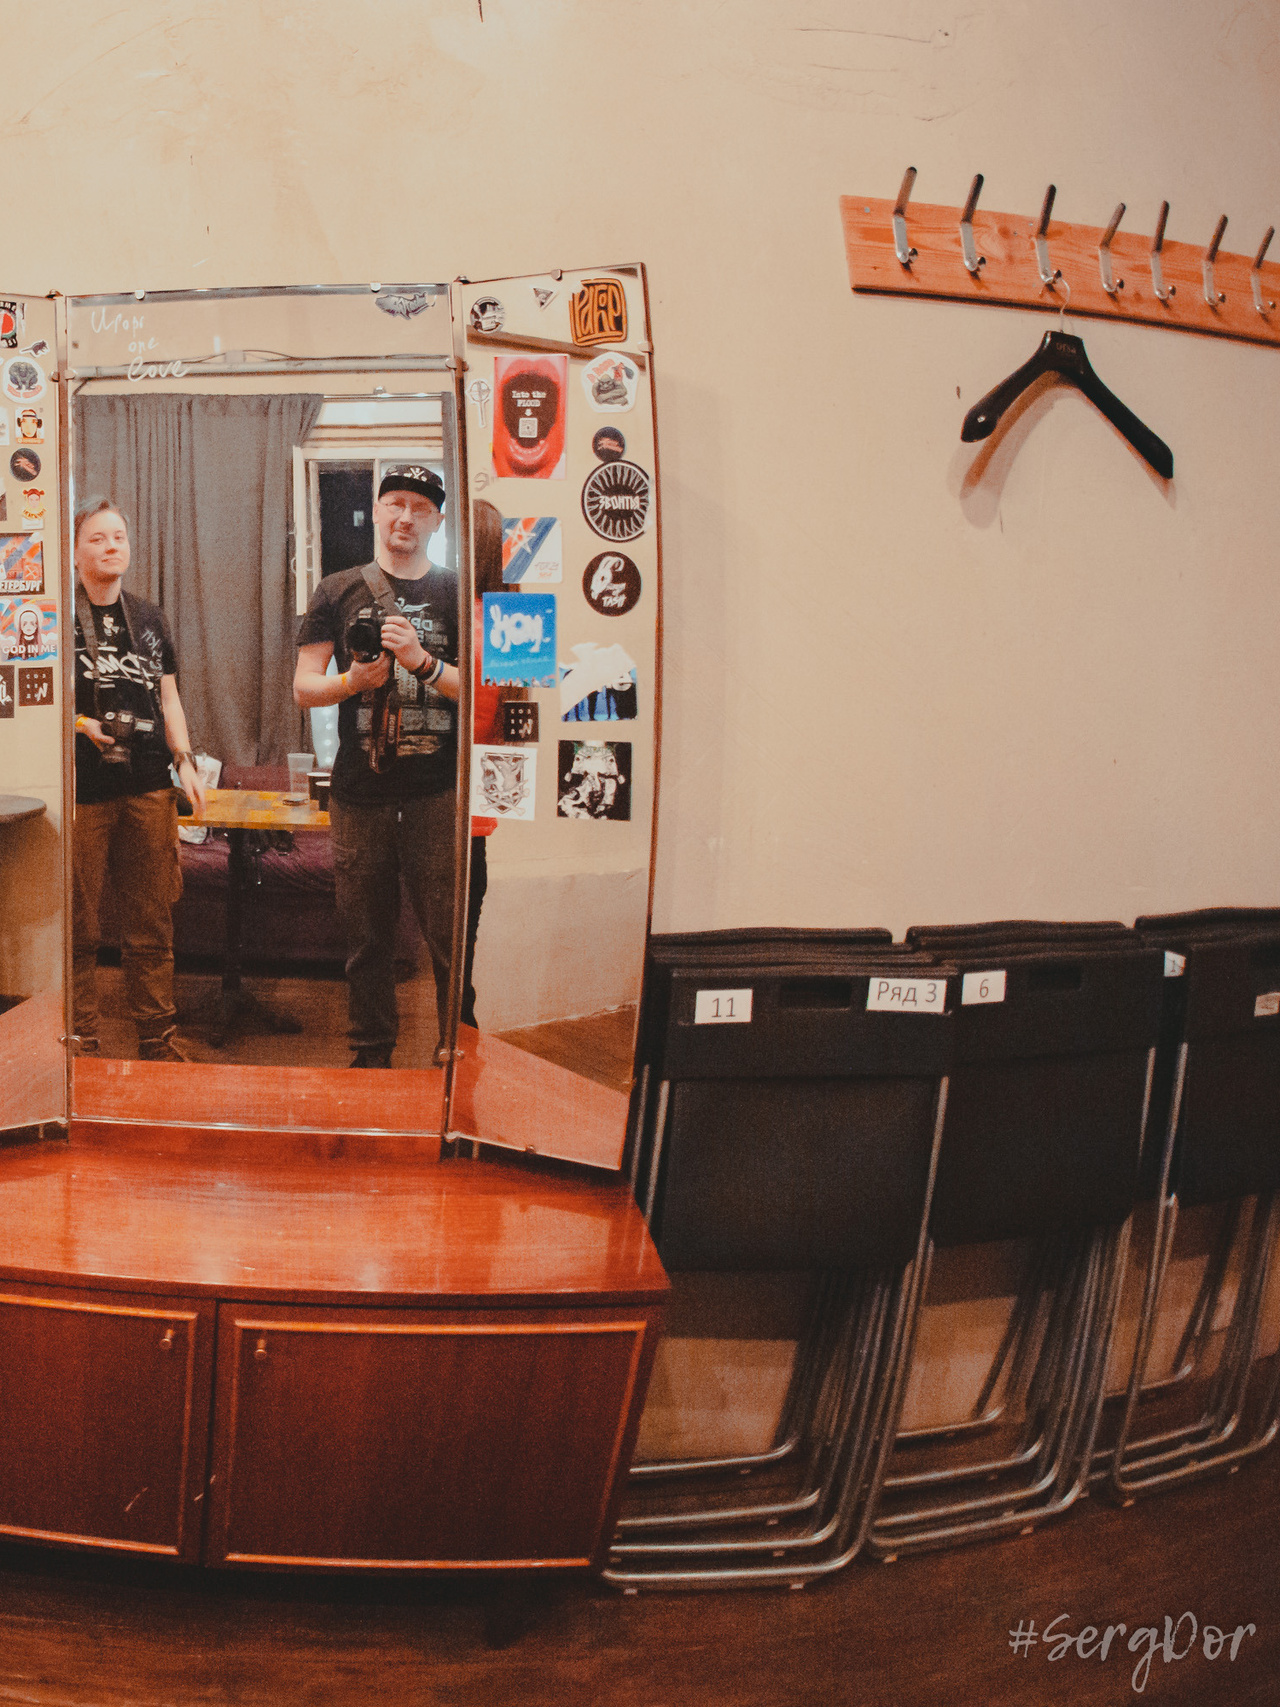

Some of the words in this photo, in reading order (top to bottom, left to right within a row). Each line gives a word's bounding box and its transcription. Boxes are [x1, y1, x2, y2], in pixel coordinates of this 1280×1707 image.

[2, 644, 26, 655] GOD
[27, 644, 39, 654] IN
[40, 643, 57, 654] ME
[877, 981, 918, 1005] Ряд
[924, 981, 938, 1003] 3
[979, 978, 990, 998] 6
[711, 996, 737, 1019] 11
